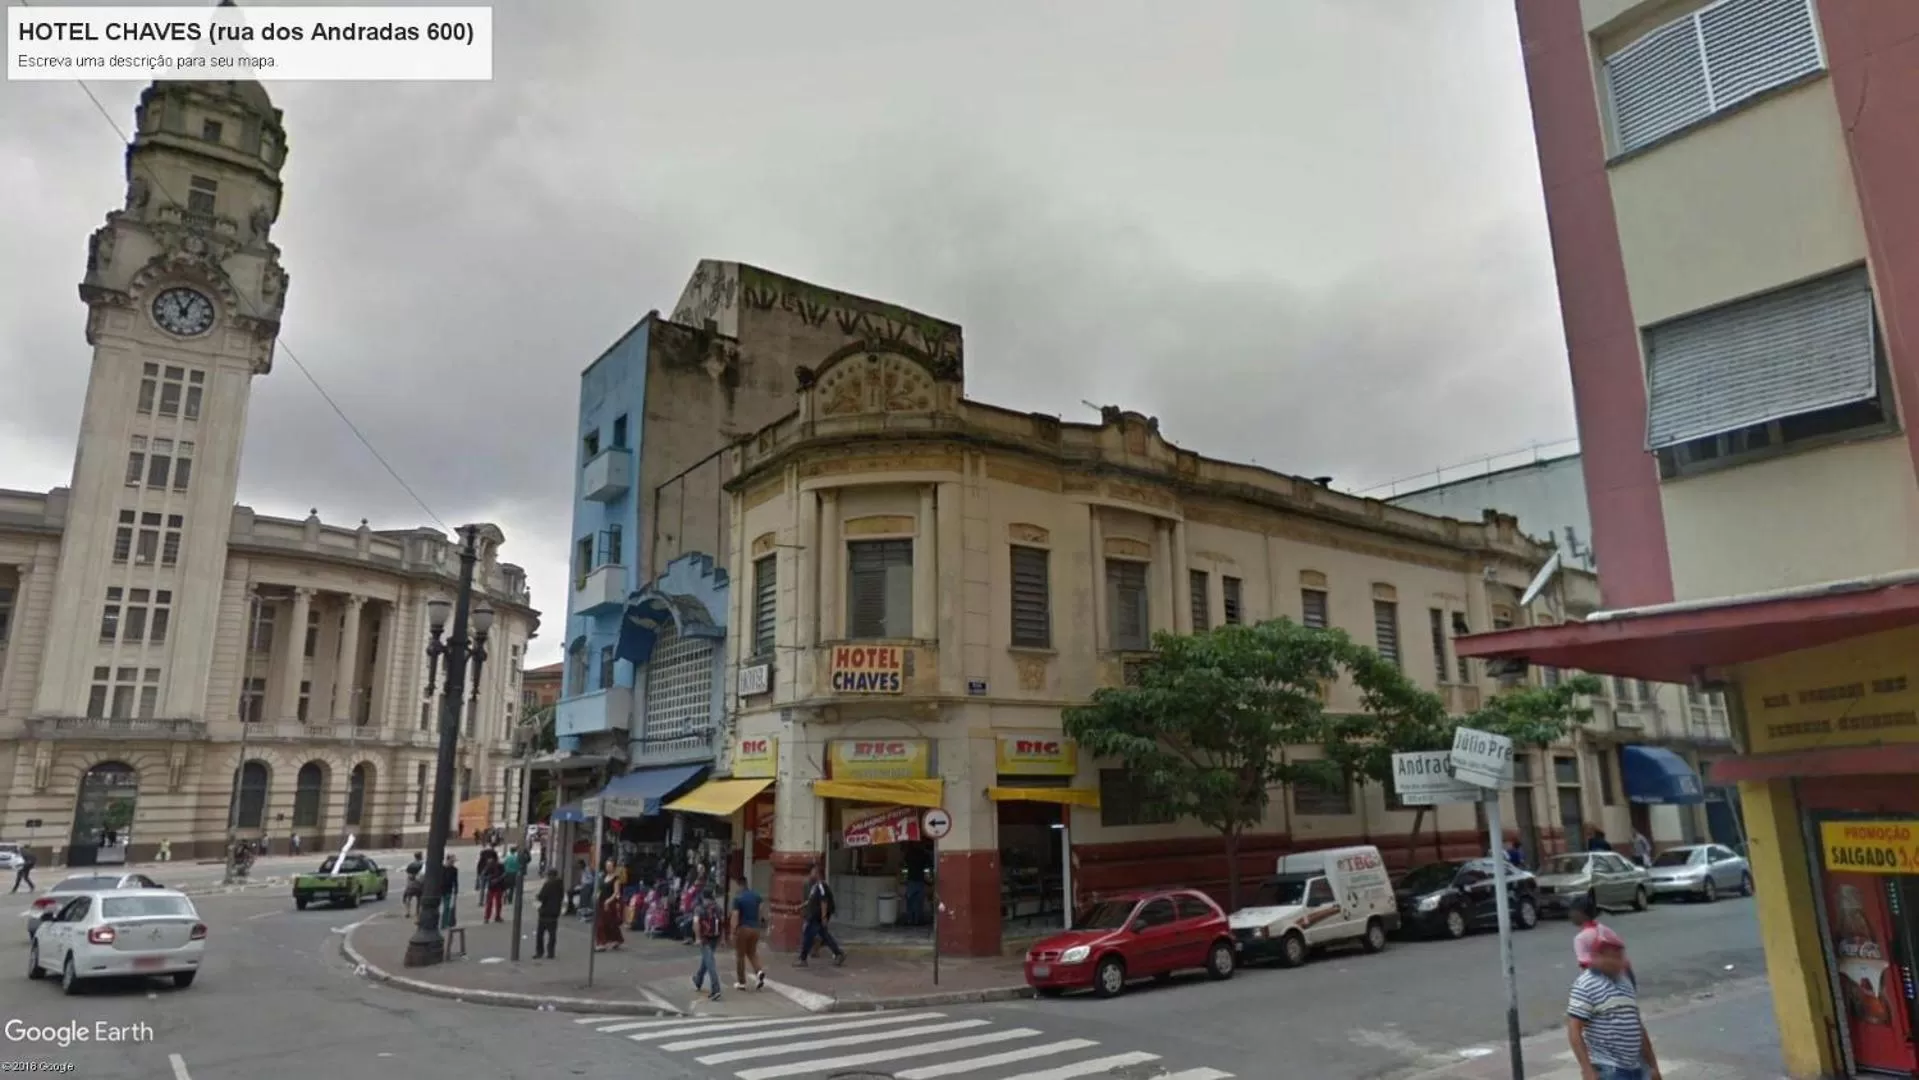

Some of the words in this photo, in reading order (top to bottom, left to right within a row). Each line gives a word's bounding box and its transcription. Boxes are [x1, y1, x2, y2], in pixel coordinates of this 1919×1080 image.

[836, 648, 899, 669] HOTEL
[833, 671, 899, 691] CHAVES
[743, 740, 767, 753] BIG
[854, 742, 906, 756] BIG
[1016, 739, 1059, 755] BIG
[1455, 733, 1486, 754] Júlio
[1488, 740, 1513, 760] Pre
[1844, 825, 1911, 842] PROMOÇÃO
[1831, 846, 1897, 867] SALGADO
